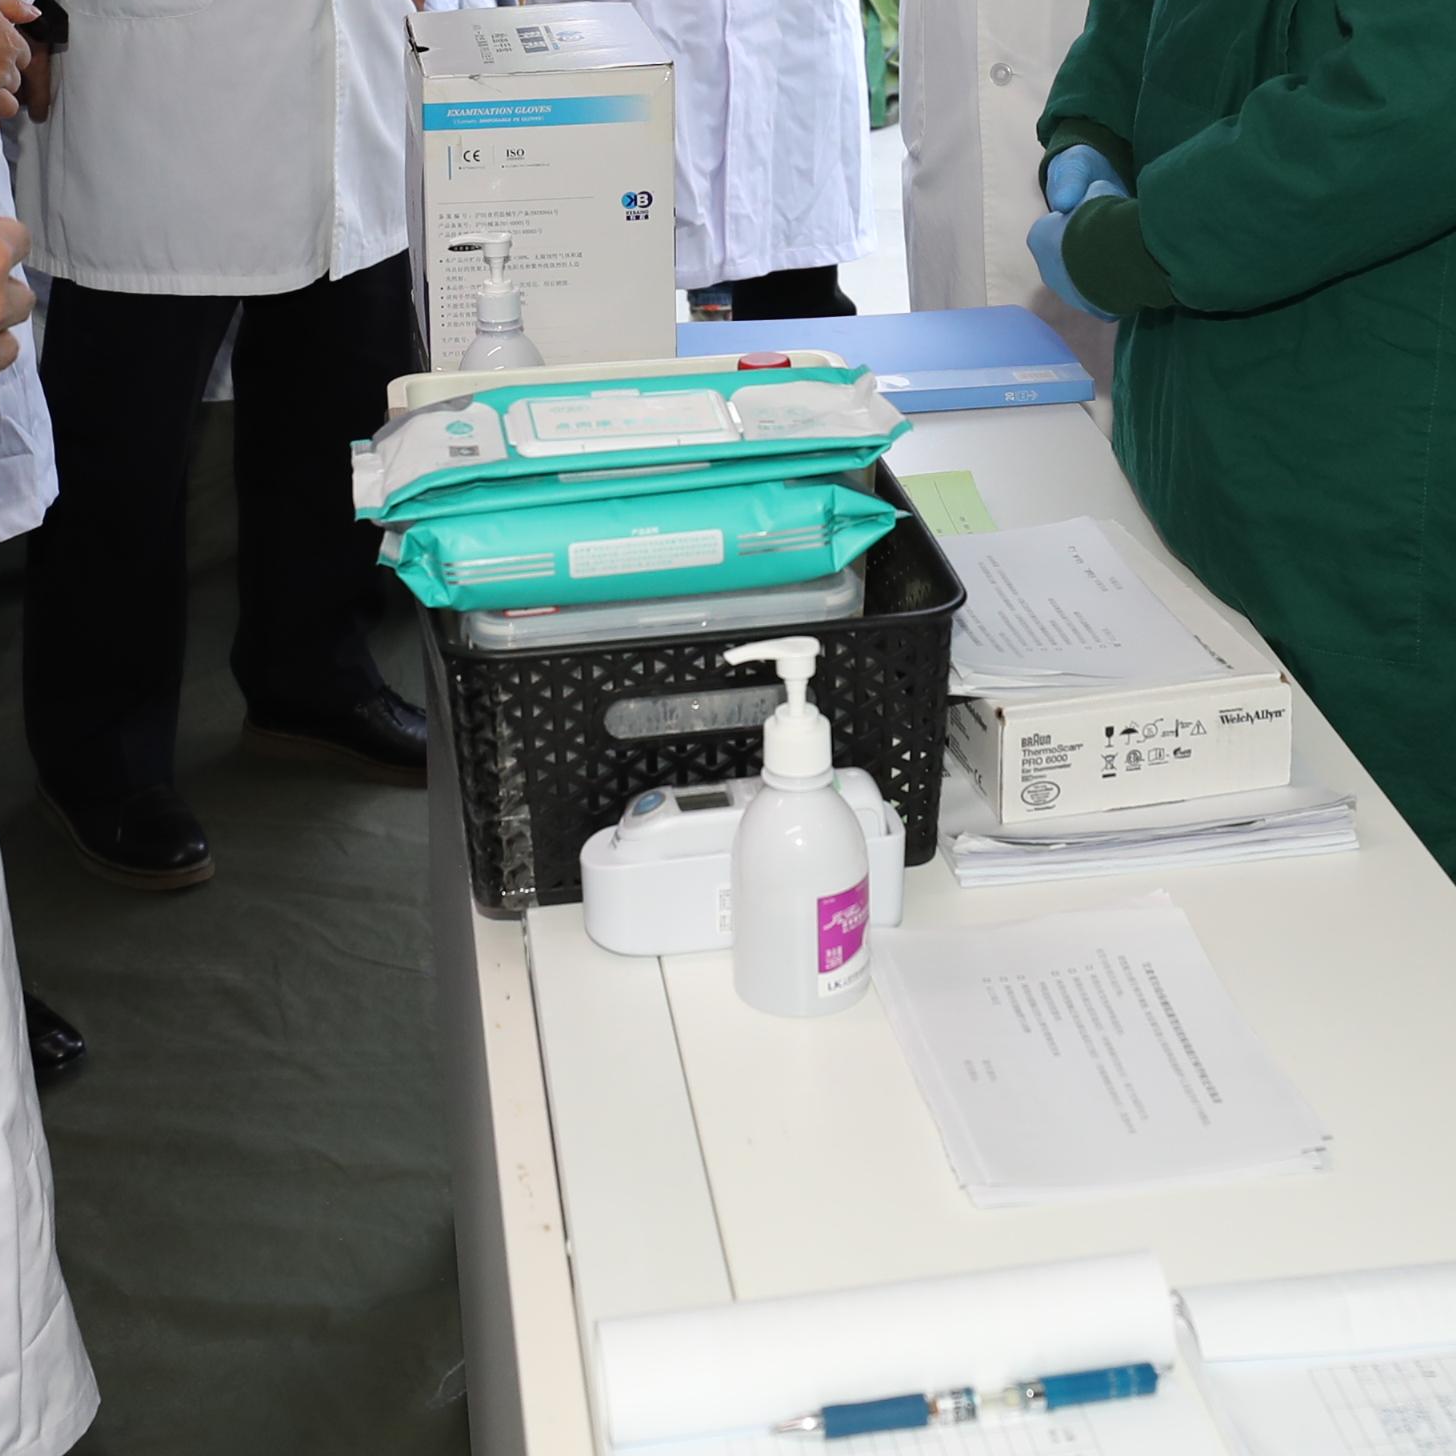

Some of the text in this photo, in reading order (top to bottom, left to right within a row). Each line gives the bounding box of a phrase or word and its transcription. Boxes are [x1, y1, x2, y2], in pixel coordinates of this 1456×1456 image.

[447, 104, 552, 118] EXAMINATION GLOVES
[506, 148, 525, 158] ISO
[1021, 733, 1052, 748] BRAUN
[1021, 754, 1068, 767] PRO 6000
